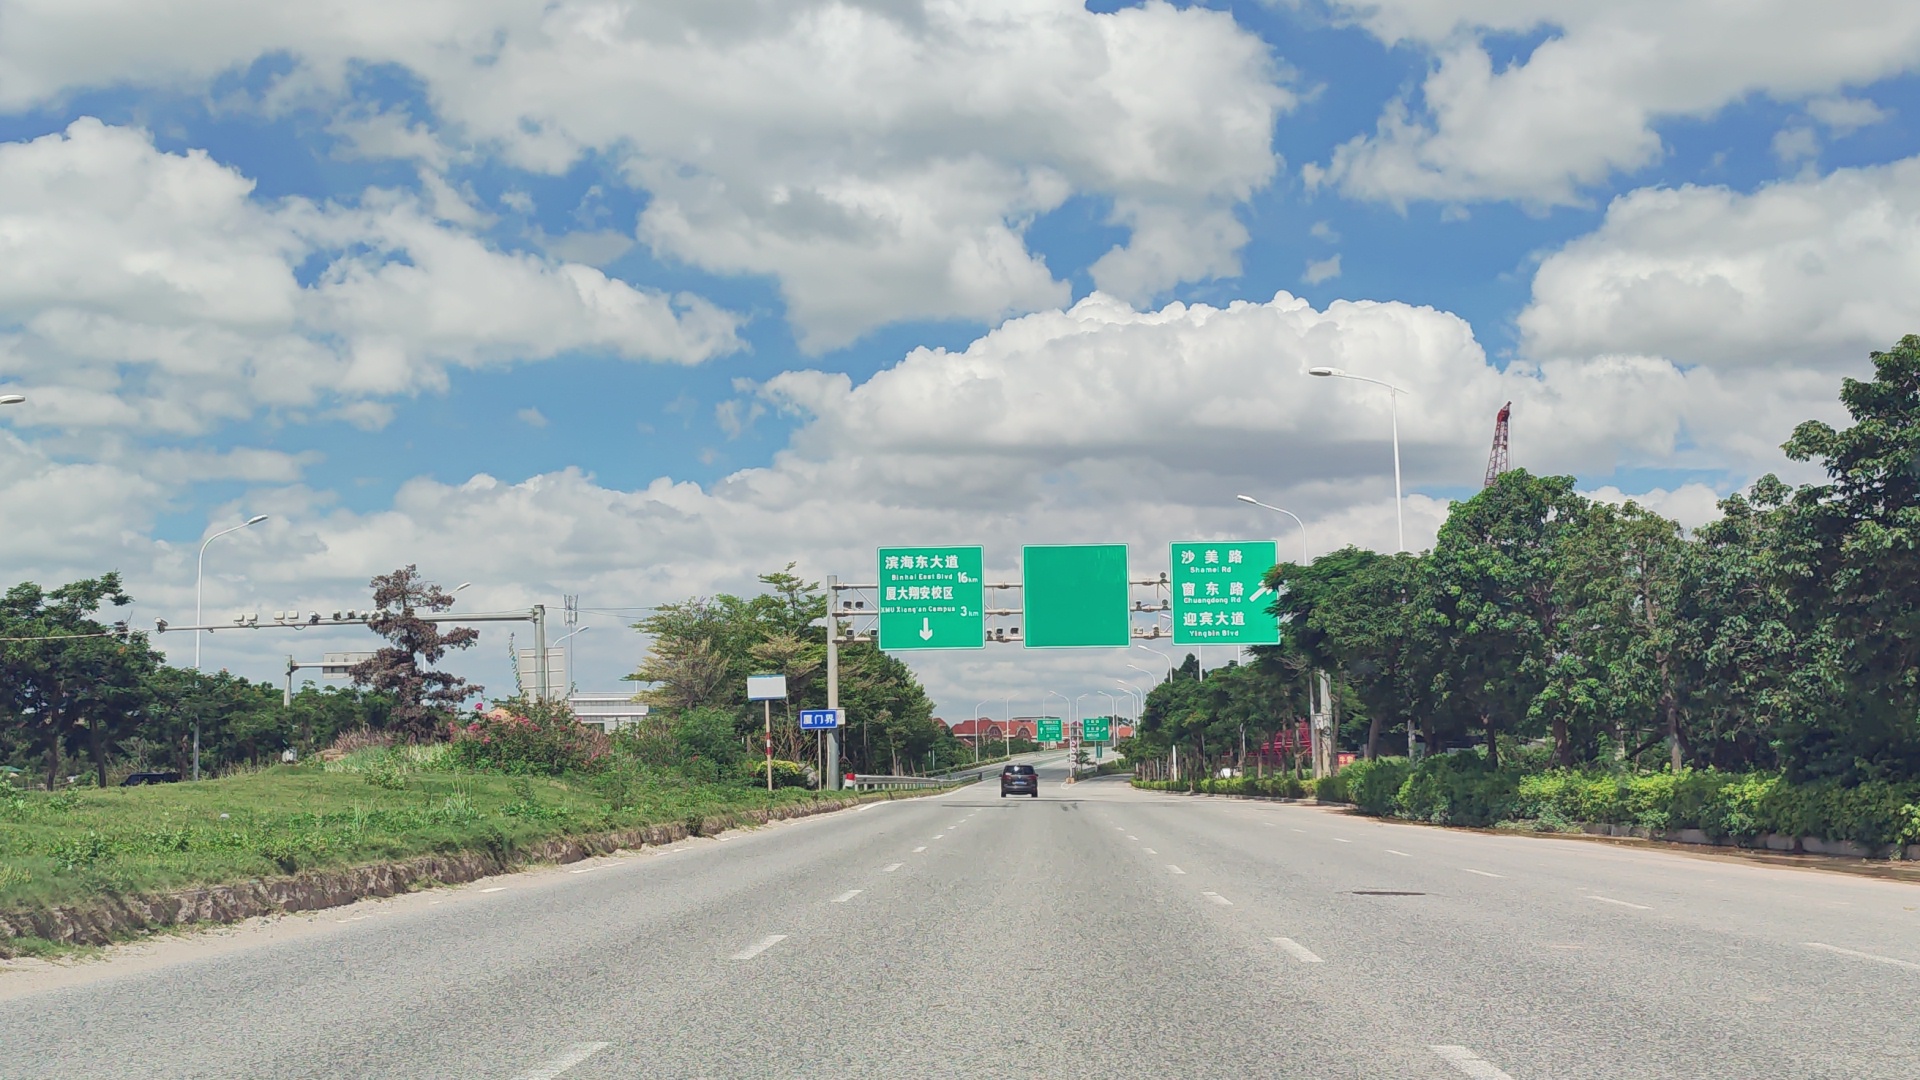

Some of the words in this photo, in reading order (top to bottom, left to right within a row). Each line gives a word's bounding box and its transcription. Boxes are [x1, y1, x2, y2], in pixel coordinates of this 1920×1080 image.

[885, 554, 959, 570] 滨海东大道
[1181, 549, 1243, 564] 沙美路
[891, 573, 917, 581] Binhai
[885, 585, 954, 601] 厦大翔安校区
[1183, 597, 1228, 605] Chuangdong
[928, 605, 956, 613] Campus
[1183, 611, 1245, 626] 迎宾大道
[1189, 630, 1220, 638] Yingbin
[1221, 629, 1239, 637] Blvd
[803, 714, 834, 725] 厦门界
